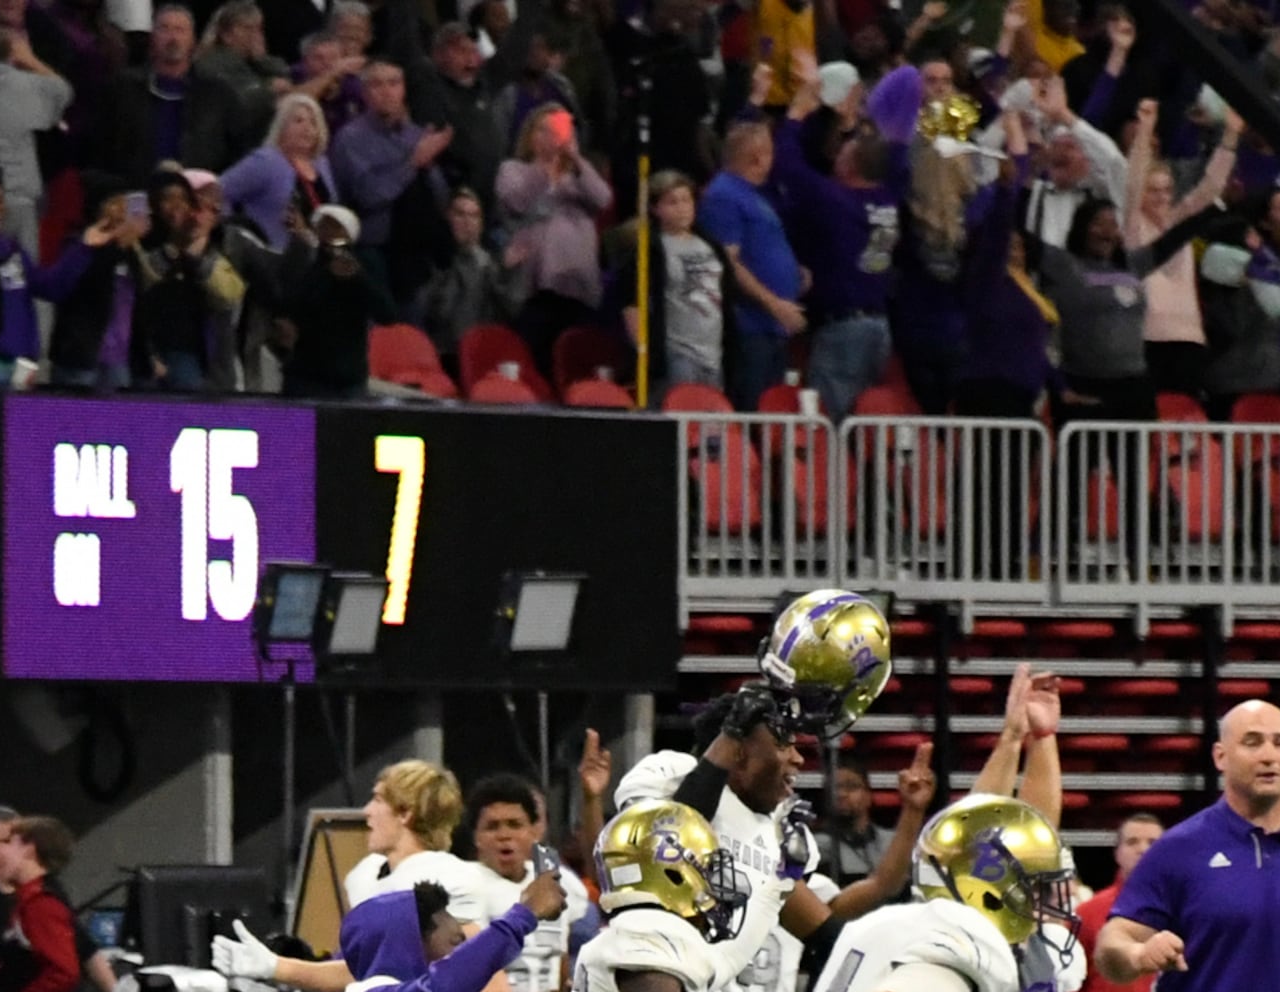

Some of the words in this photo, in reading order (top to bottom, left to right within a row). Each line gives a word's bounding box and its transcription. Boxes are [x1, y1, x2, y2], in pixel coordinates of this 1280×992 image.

[53, 443, 136, 518] BALL
[169, 427, 259, 621] 15
[374, 435, 425, 625] 7
[53, 532, 101, 606] ON
